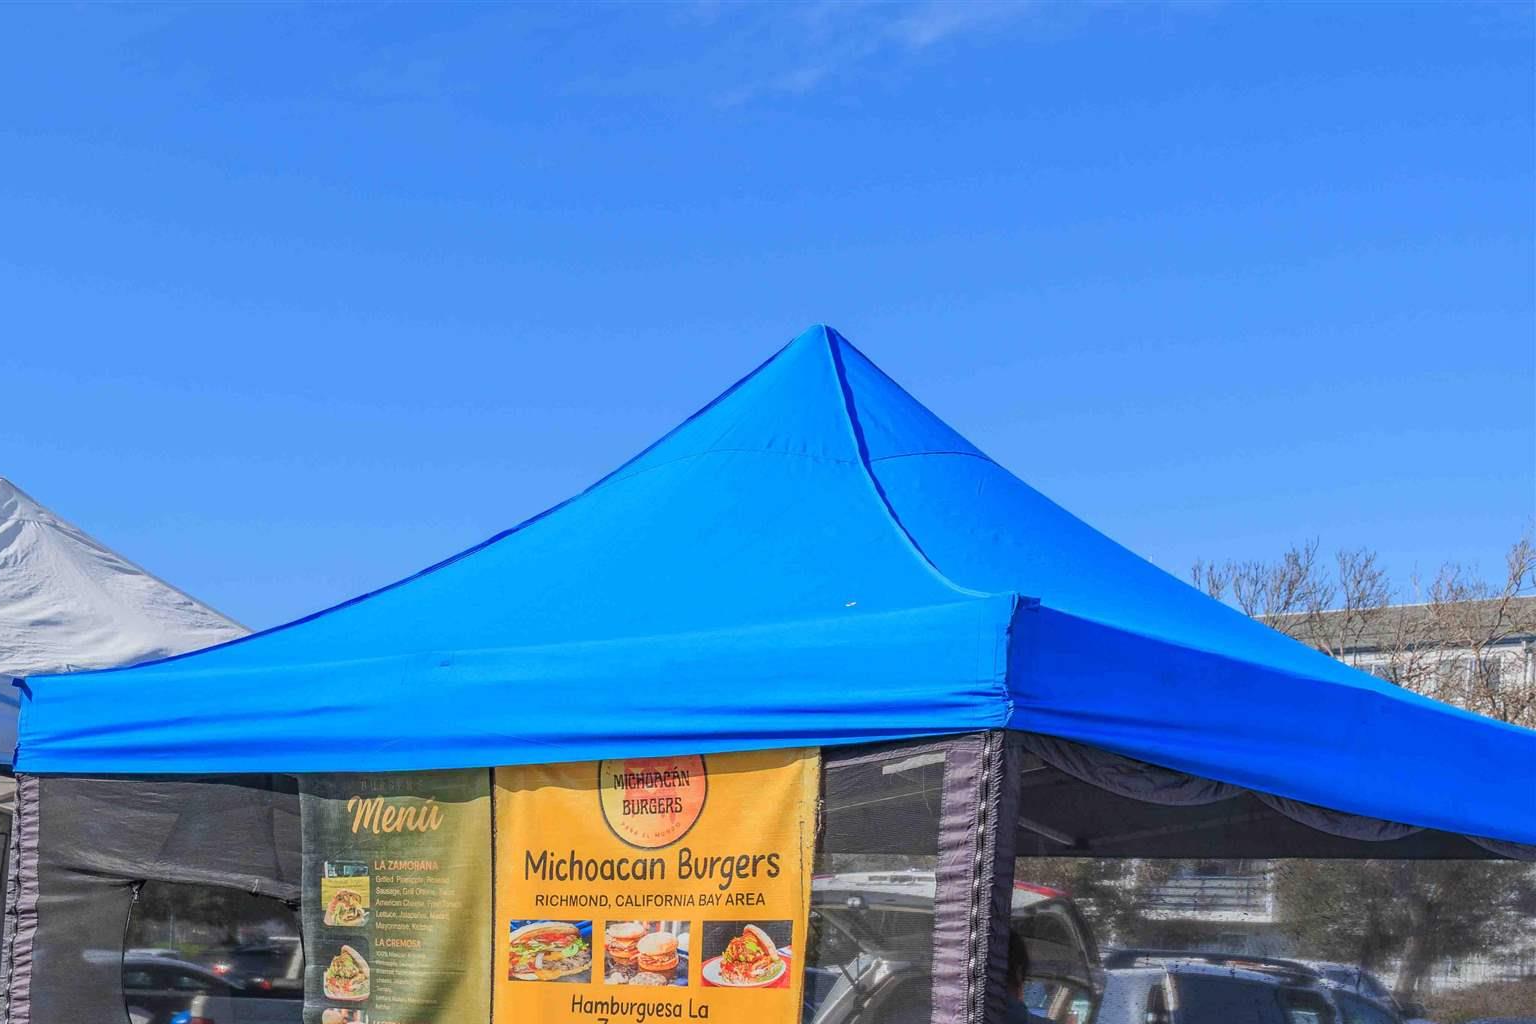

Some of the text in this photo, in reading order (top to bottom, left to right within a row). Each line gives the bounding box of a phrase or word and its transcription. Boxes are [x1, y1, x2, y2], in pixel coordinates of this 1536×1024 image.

[613, 766, 690, 790] MICHOACÁN
[622, 797, 683, 816] BURGERS
[524, 847, 781, 891] Michoacan Burgers
[535, 892, 765, 910] RICHMOND, CALIFORNIA BAY AREA
[571, 995, 709, 1022] Hamburguesa La
